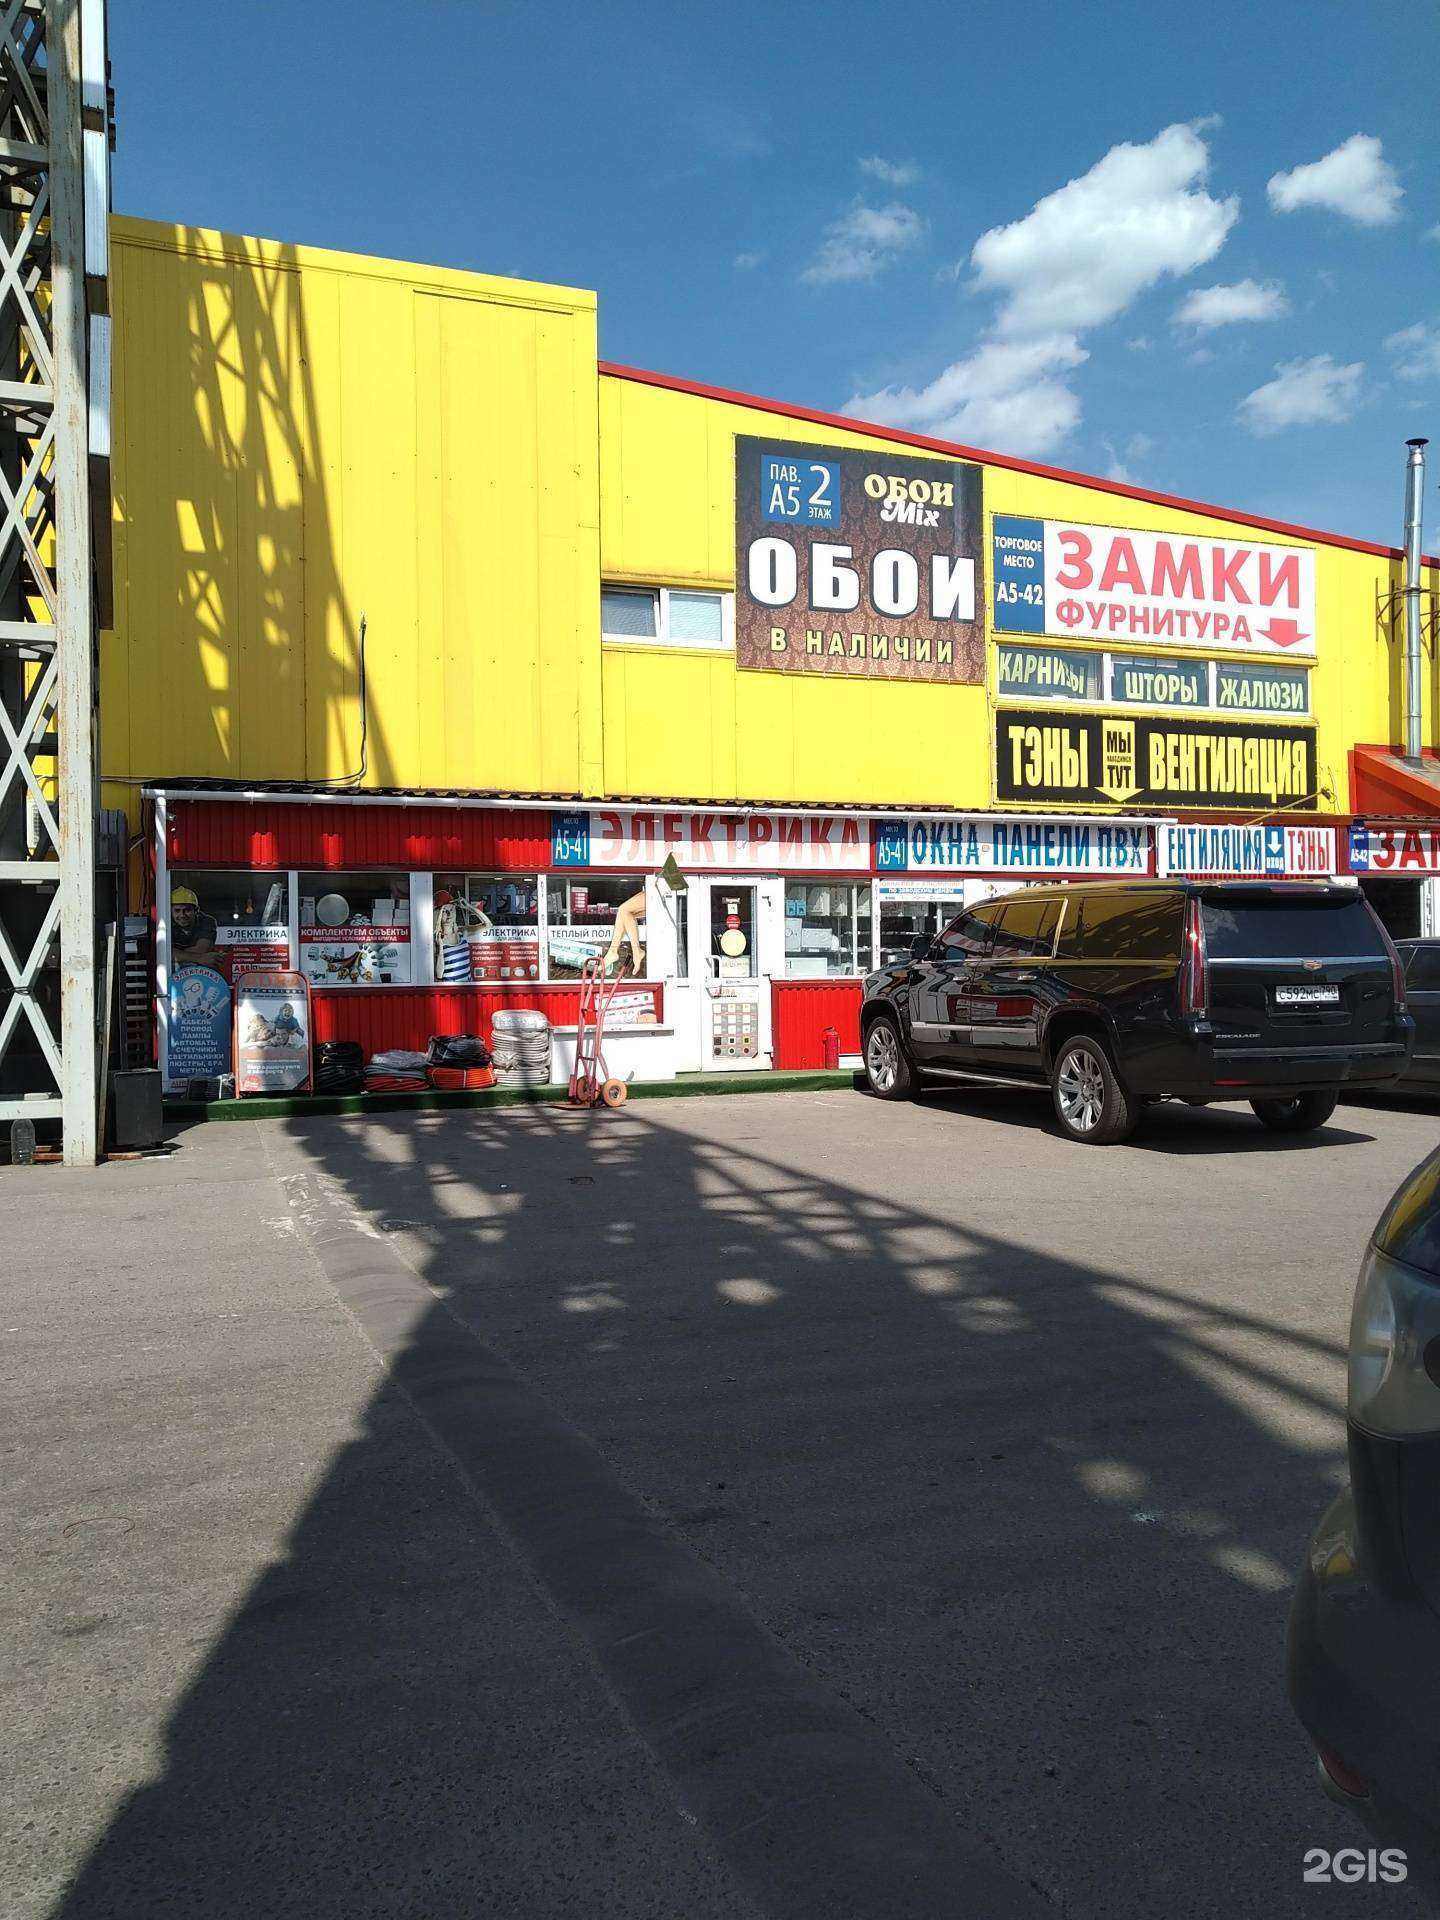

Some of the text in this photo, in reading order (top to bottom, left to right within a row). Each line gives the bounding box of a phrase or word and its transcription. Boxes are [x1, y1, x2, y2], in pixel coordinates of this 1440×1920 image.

[770, 463, 801, 482] ПАВ.
[808, 465, 832, 505] 2
[864, 473, 954, 507] ОБОИ
[808, 506, 832, 519] ЭТАЖ
[880, 498, 940, 528] Mix
[994, 536, 1043, 551] ТОРГОВОЕ
[1003, 555, 1035, 569] МЕСТО
[1055, 530, 1300, 610] ЗАМКИ
[748, 536, 976, 621] ОБОИ
[996, 582, 1044, 606] А5-42
[1056, 599, 1253, 643] ФУРНИТУРА
[770, 627, 954, 665] В НАЛИЧИИ
[1125, 671, 1198, 704] ШТОРЫ
[1220, 677, 1304, 711] ЖАЛЮЗИ
[1008, 725, 1089, 788] ТЭНЫ
[1106, 730, 1131, 753] МЫ
[1106, 764, 1131, 788] ТУТ
[1149, 732, 1307, 804] ВЕНТИЛЯЦИЯ
[555, 828, 587, 860] А5-41
[600, 811, 862, 863] ЭЛЕКТРИКА
[879, 836, 905, 865] А5-41
[912, 821, 1143, 867] ОКНА ПАНЕЛИ ПВХ
[1168, 827, 1262, 872] ЕНТИЛЯЦИЯ
[1287, 830, 1330, 870] ТЭНЫ
[1266, 857, 1284, 870] ВХОД
[226, 929, 287, 938] ЭЛЕКТРИКА
[301, 928, 408, 936] КОМПЛЕКТУЕМ ОБЪЕКТЫ
[482, 928, 537, 937] ЭЛЕКТРИКА
[551, 927, 612, 938] ТЕПЛЫЙ ПОЛ
